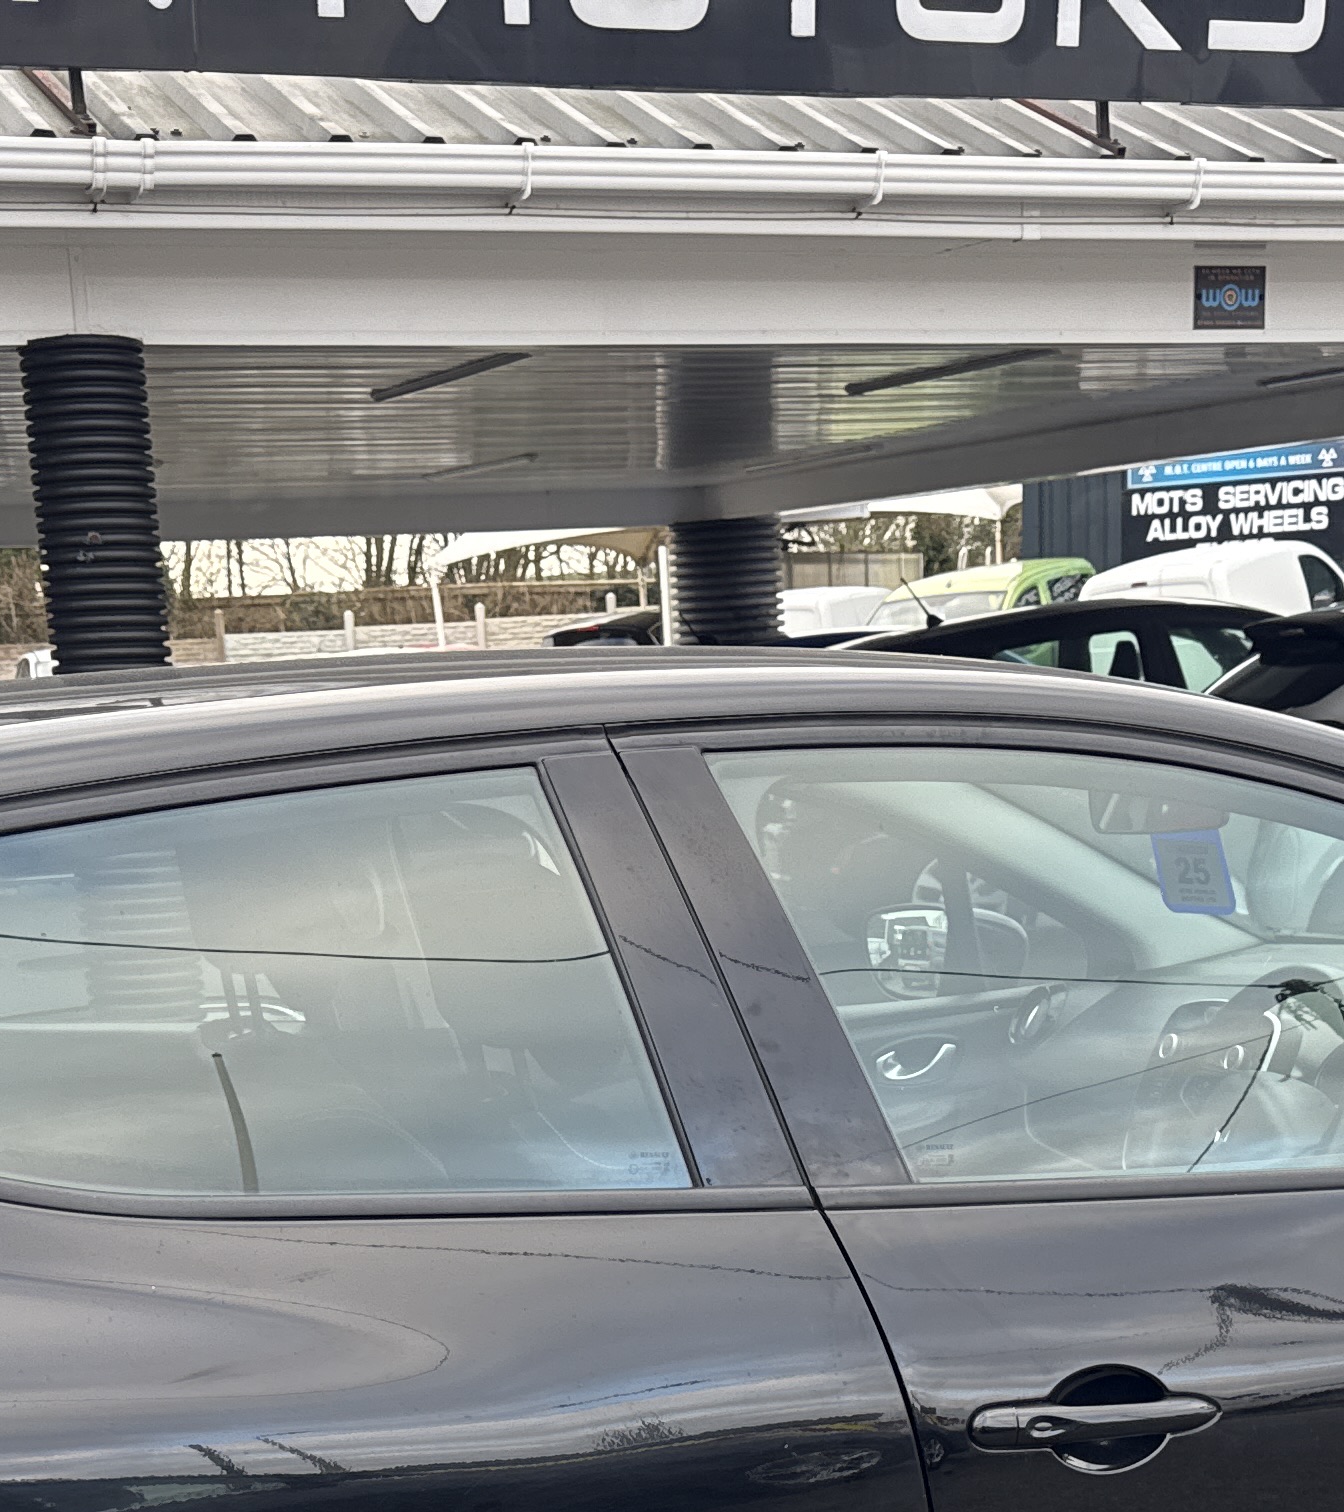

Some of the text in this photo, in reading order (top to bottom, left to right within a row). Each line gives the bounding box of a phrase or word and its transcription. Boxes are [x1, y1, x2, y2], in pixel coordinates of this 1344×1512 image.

[1224, 458, 1248, 471] OPEN
[1256, 455, 1279, 469] DAYS
[1288, 453, 1313, 466] WEEK
[1146, 506, 1329, 542] ALLOY WHEELS
[1176, 857, 1211, 885] 25
